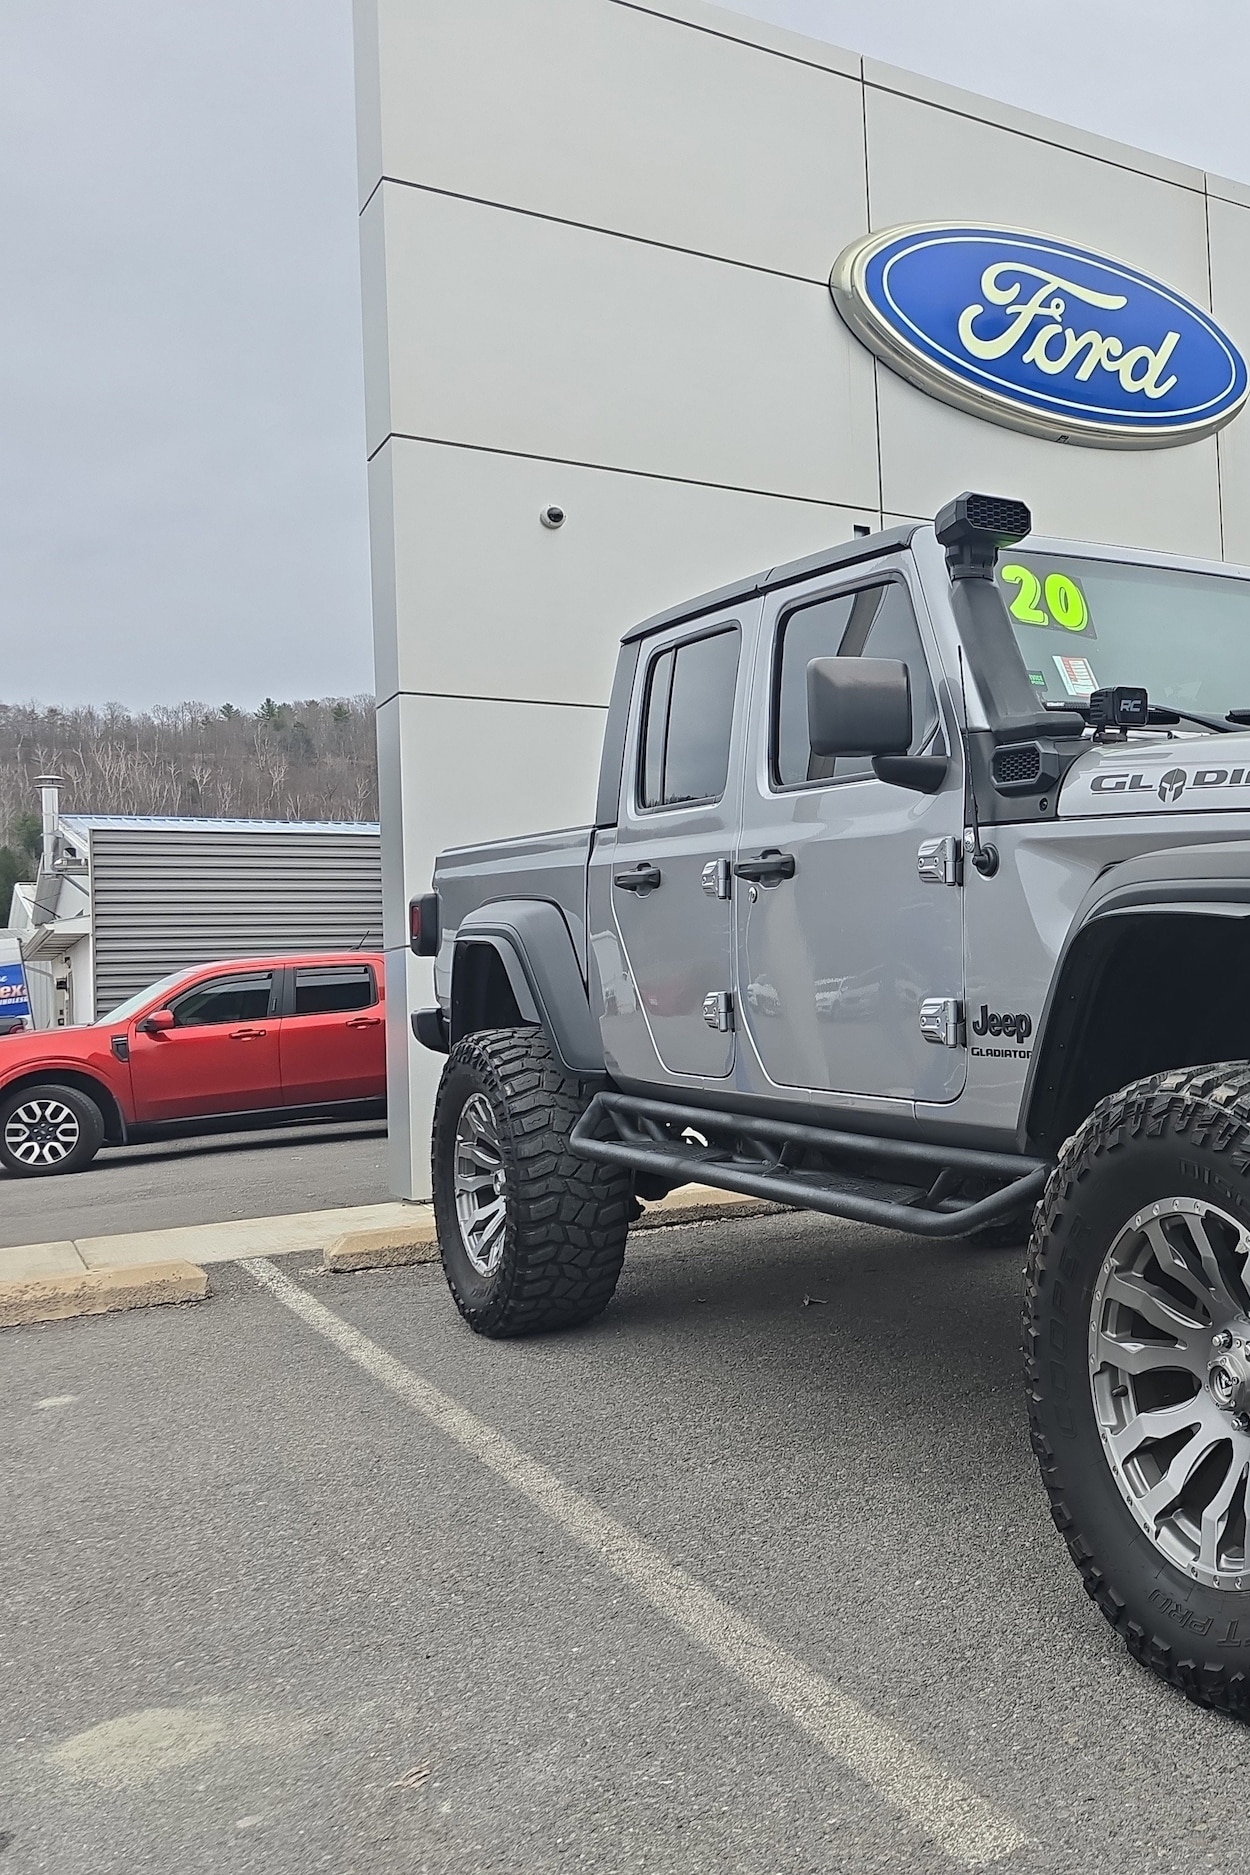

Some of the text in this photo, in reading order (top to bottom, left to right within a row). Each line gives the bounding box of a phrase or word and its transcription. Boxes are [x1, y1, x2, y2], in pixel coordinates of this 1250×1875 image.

[958, 262, 1181, 400] Ford
[1001, 564, 1089, 632] 20
[1120, 699, 1142, 712] RC
[973, 1004, 1032, 1044] Jeep
